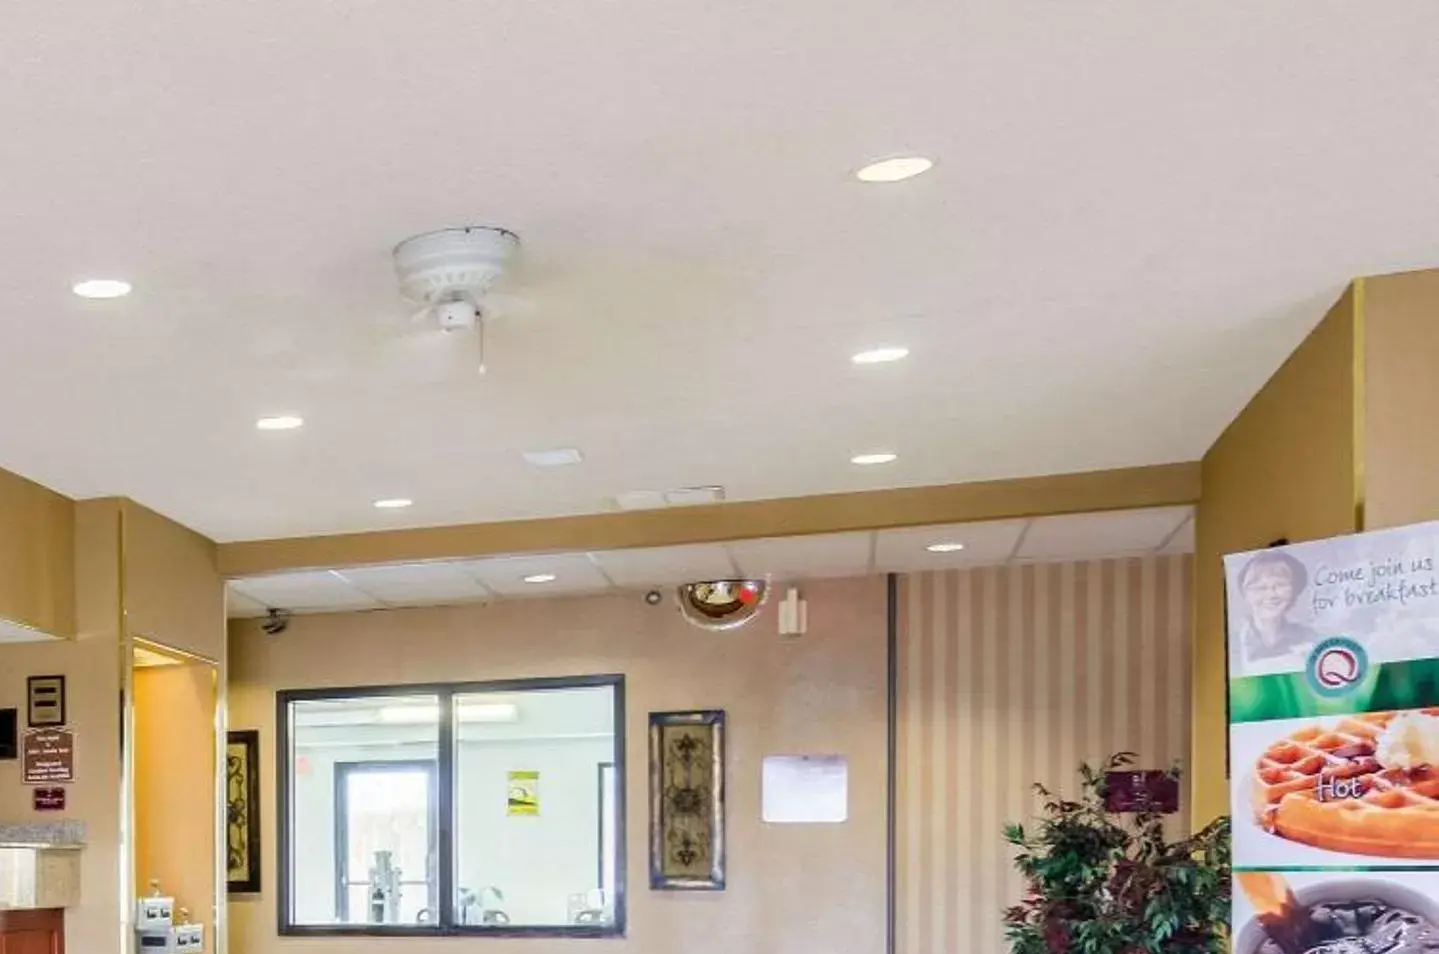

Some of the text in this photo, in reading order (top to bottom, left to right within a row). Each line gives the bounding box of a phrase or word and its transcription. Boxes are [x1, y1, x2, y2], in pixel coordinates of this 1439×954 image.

[1314, 557, 1433, 588] Come join us
[1313, 577, 1439, 614] for breakfast
[1316, 772, 1361, 802] Hot
